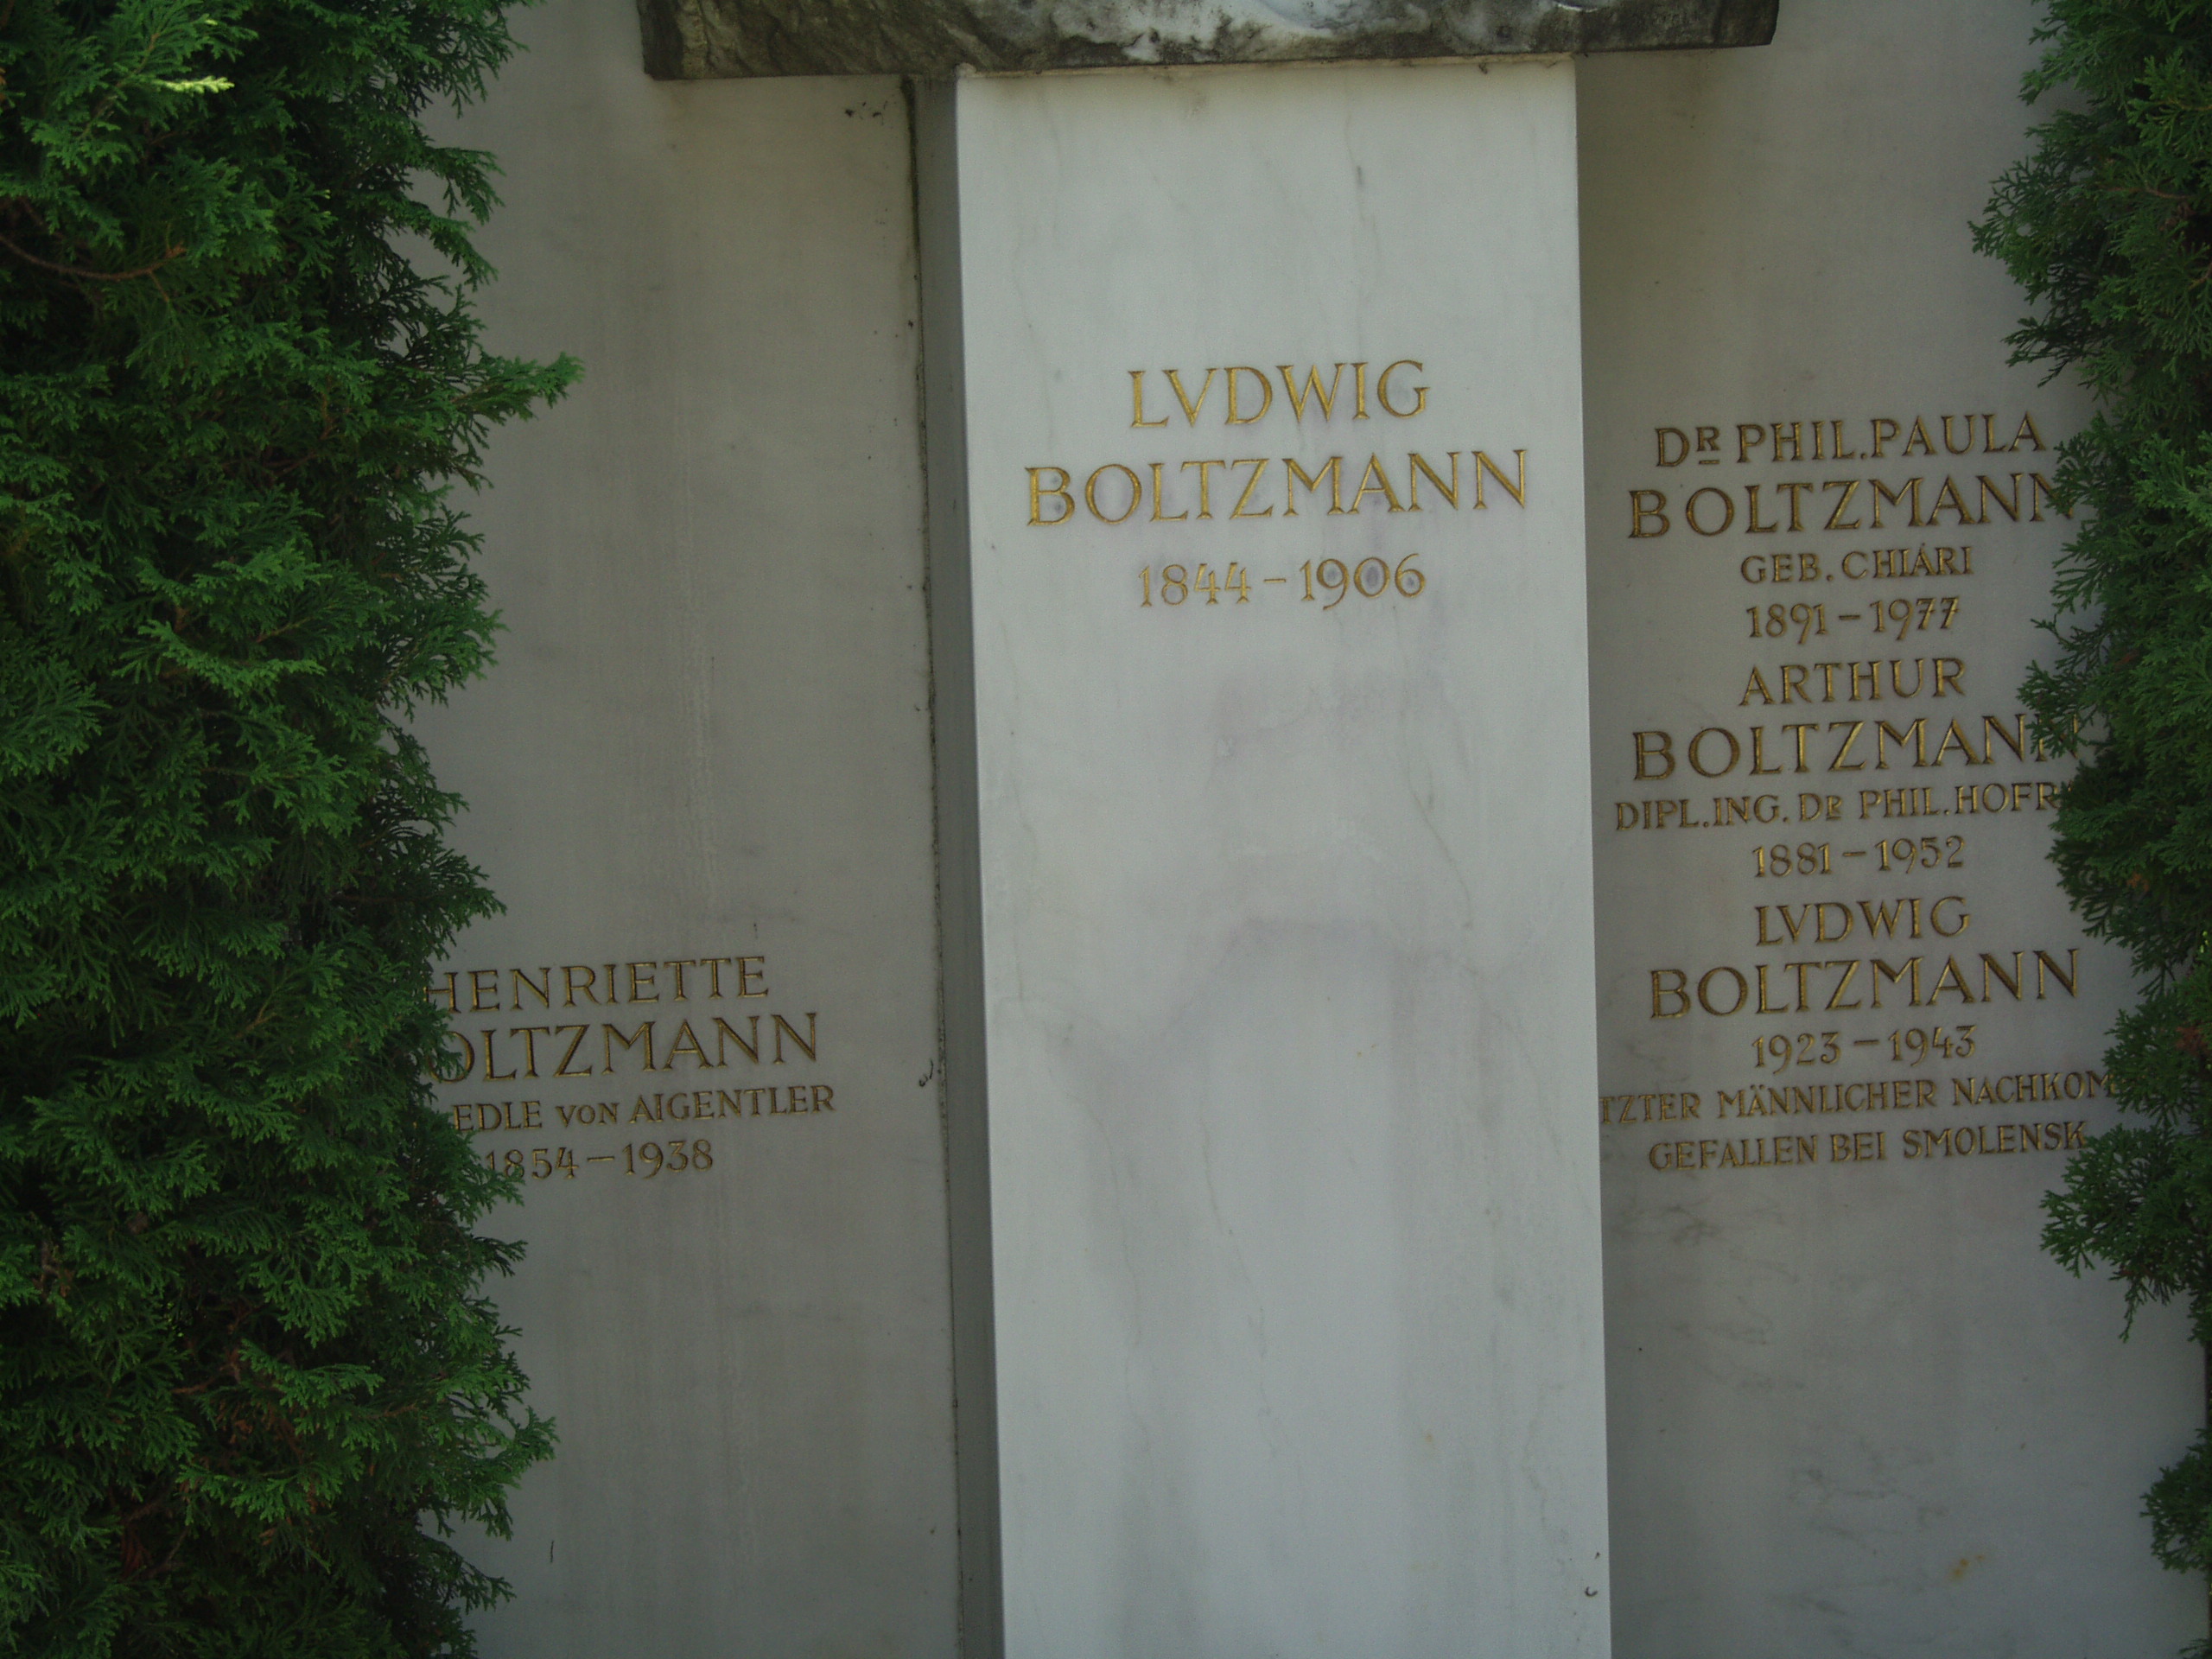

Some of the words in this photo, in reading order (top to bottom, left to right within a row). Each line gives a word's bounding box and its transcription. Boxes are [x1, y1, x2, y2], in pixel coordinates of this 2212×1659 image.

[1128, 359, 1429, 428] LVDWIG
[1024, 448, 1528, 526] BOLTZMANN
[1738, 658, 1966, 706] ARTHUR
[1755, 896, 1970, 946] LVDWIG
[1649, 948, 2079, 1020] BOLTZMANN
[427, 1012, 817, 1084] OLTZMANN
[452, 1099, 543, 1132] EDLE
[555, 1103, 619, 1128] VON
[629, 1084, 836, 1124] AIGENTLER
[1599, 1092, 1701, 1124] TZTER
[1717, 1080, 1937, 1121] MÄNNLICHER
[1649, 1135, 1816, 1172] GEFALLEN
[1829, 1131, 1887, 1162] BEI
[1903, 1121, 2088, 1159] SMOLENSK
